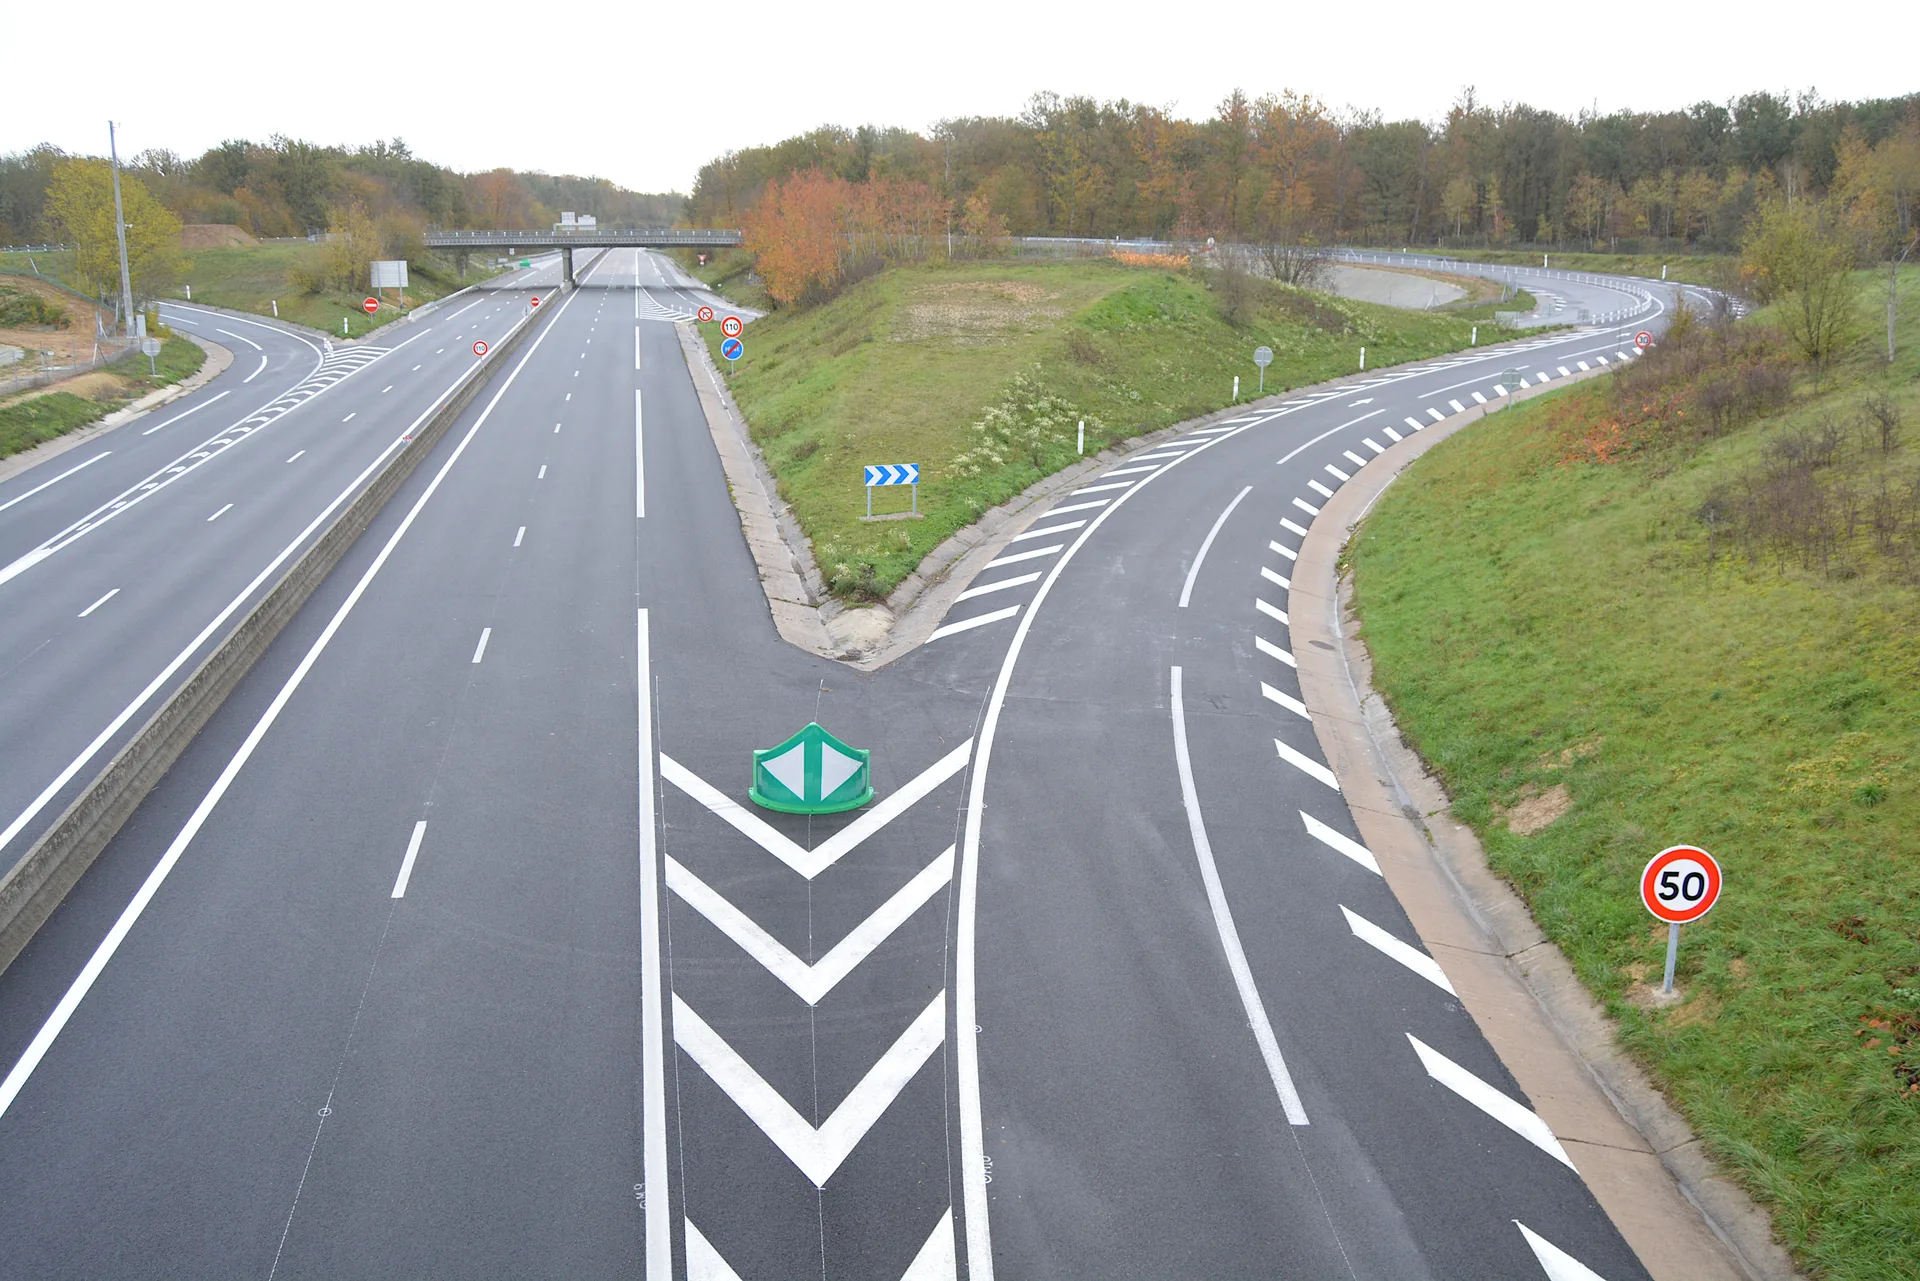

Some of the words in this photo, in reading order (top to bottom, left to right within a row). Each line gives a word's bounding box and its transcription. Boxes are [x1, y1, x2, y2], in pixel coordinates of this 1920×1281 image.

[725, 323, 739, 331] 110
[1640, 336, 1649, 344] 30
[1658, 871, 1705, 902] 50
